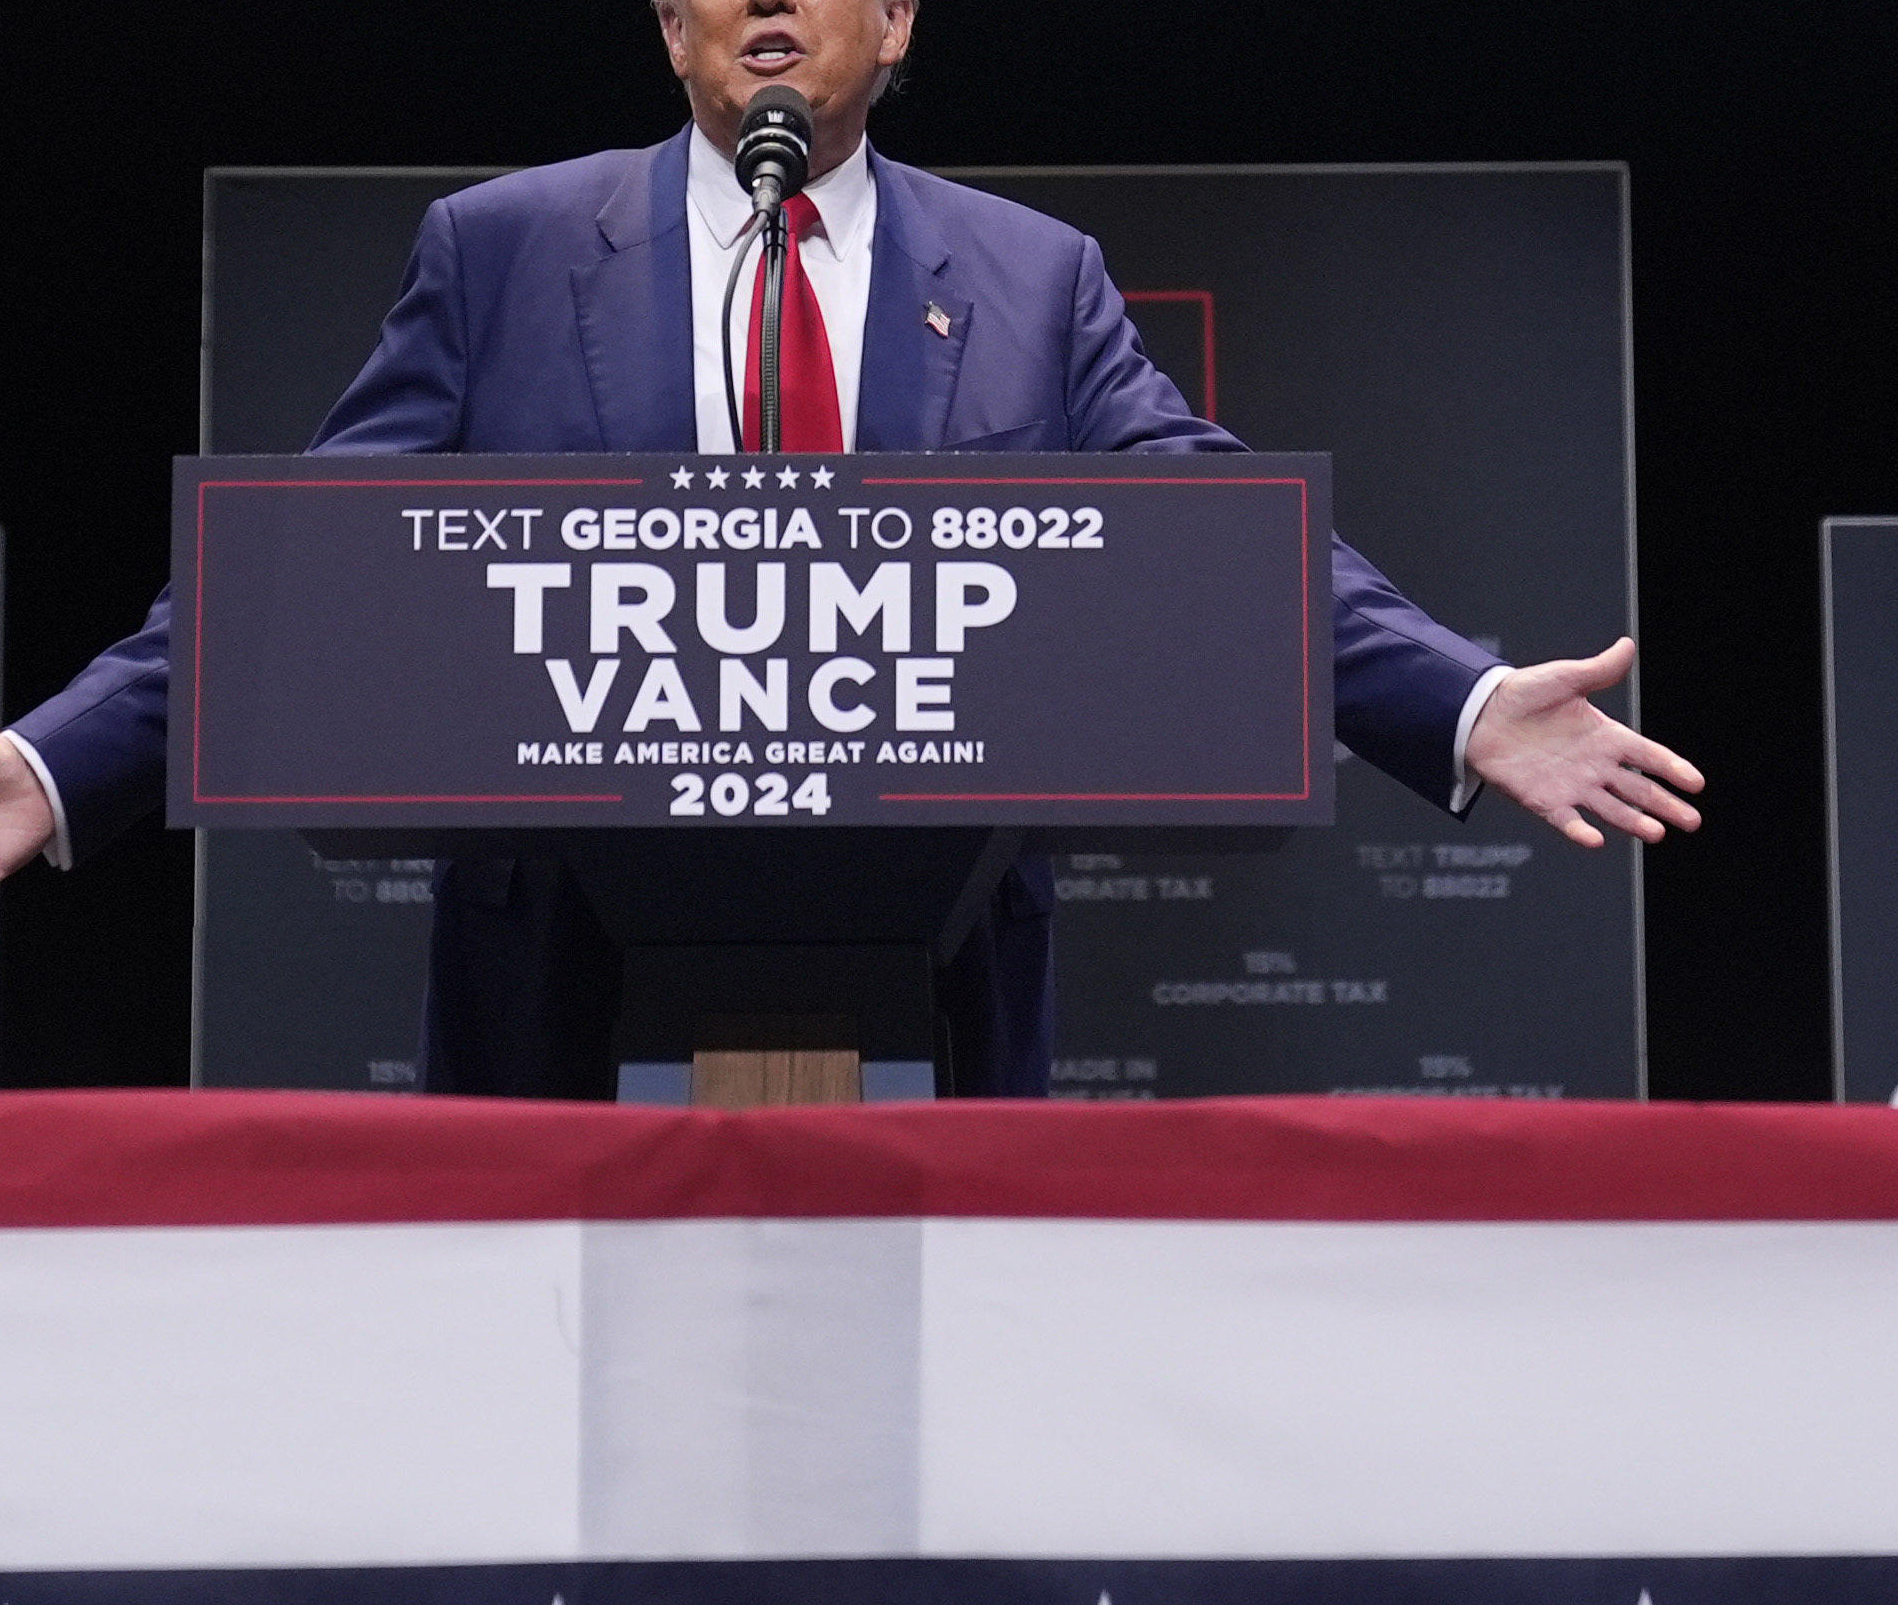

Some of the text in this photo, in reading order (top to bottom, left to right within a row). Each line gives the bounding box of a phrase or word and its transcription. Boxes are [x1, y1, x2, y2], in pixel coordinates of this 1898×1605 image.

[400, 506, 1104, 551] TEXT GEORGIA TO 88022
[485, 560, 1018, 655] TRUMP
[543, 656, 955, 733] VANCE
[517, 740, 985, 765] MAKE AMERICA GREAT AGAIN!
[669, 772, 832, 817] 2024
[375, 879, 435, 903] 880
[1054, 876, 1147, 900] ORATE
